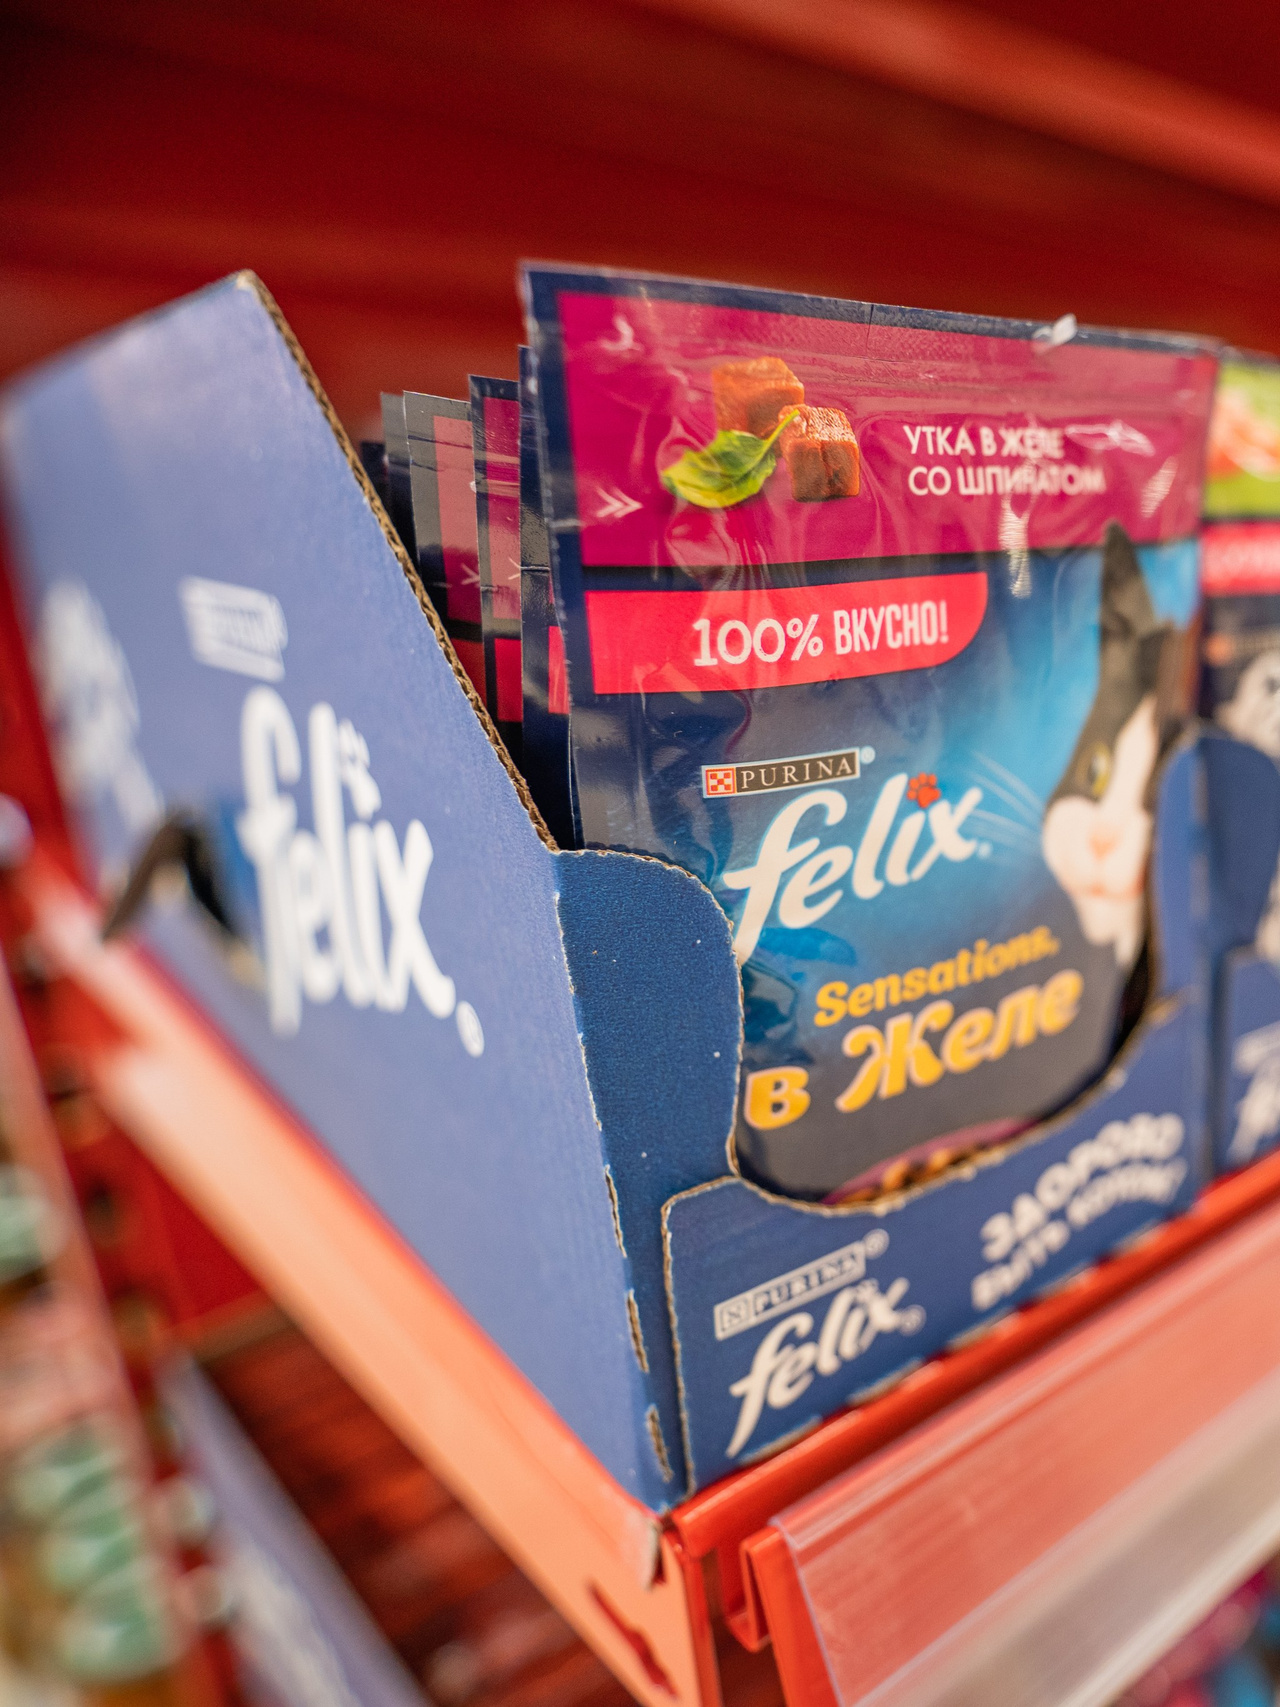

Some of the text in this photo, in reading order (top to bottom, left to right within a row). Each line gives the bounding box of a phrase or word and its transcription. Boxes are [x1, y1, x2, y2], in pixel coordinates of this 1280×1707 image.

[902, 424, 976, 456] УТКА
[979, 426, 997, 456] В
[908, 465, 951, 496] СО
[692, 600, 949, 667] 100% ВКУСНО!
[740, 756, 853, 789] PURINA
[236, 686, 456, 1037] felix
[722, 773, 982, 967] felix
[726, 1277, 910, 1458] felix
